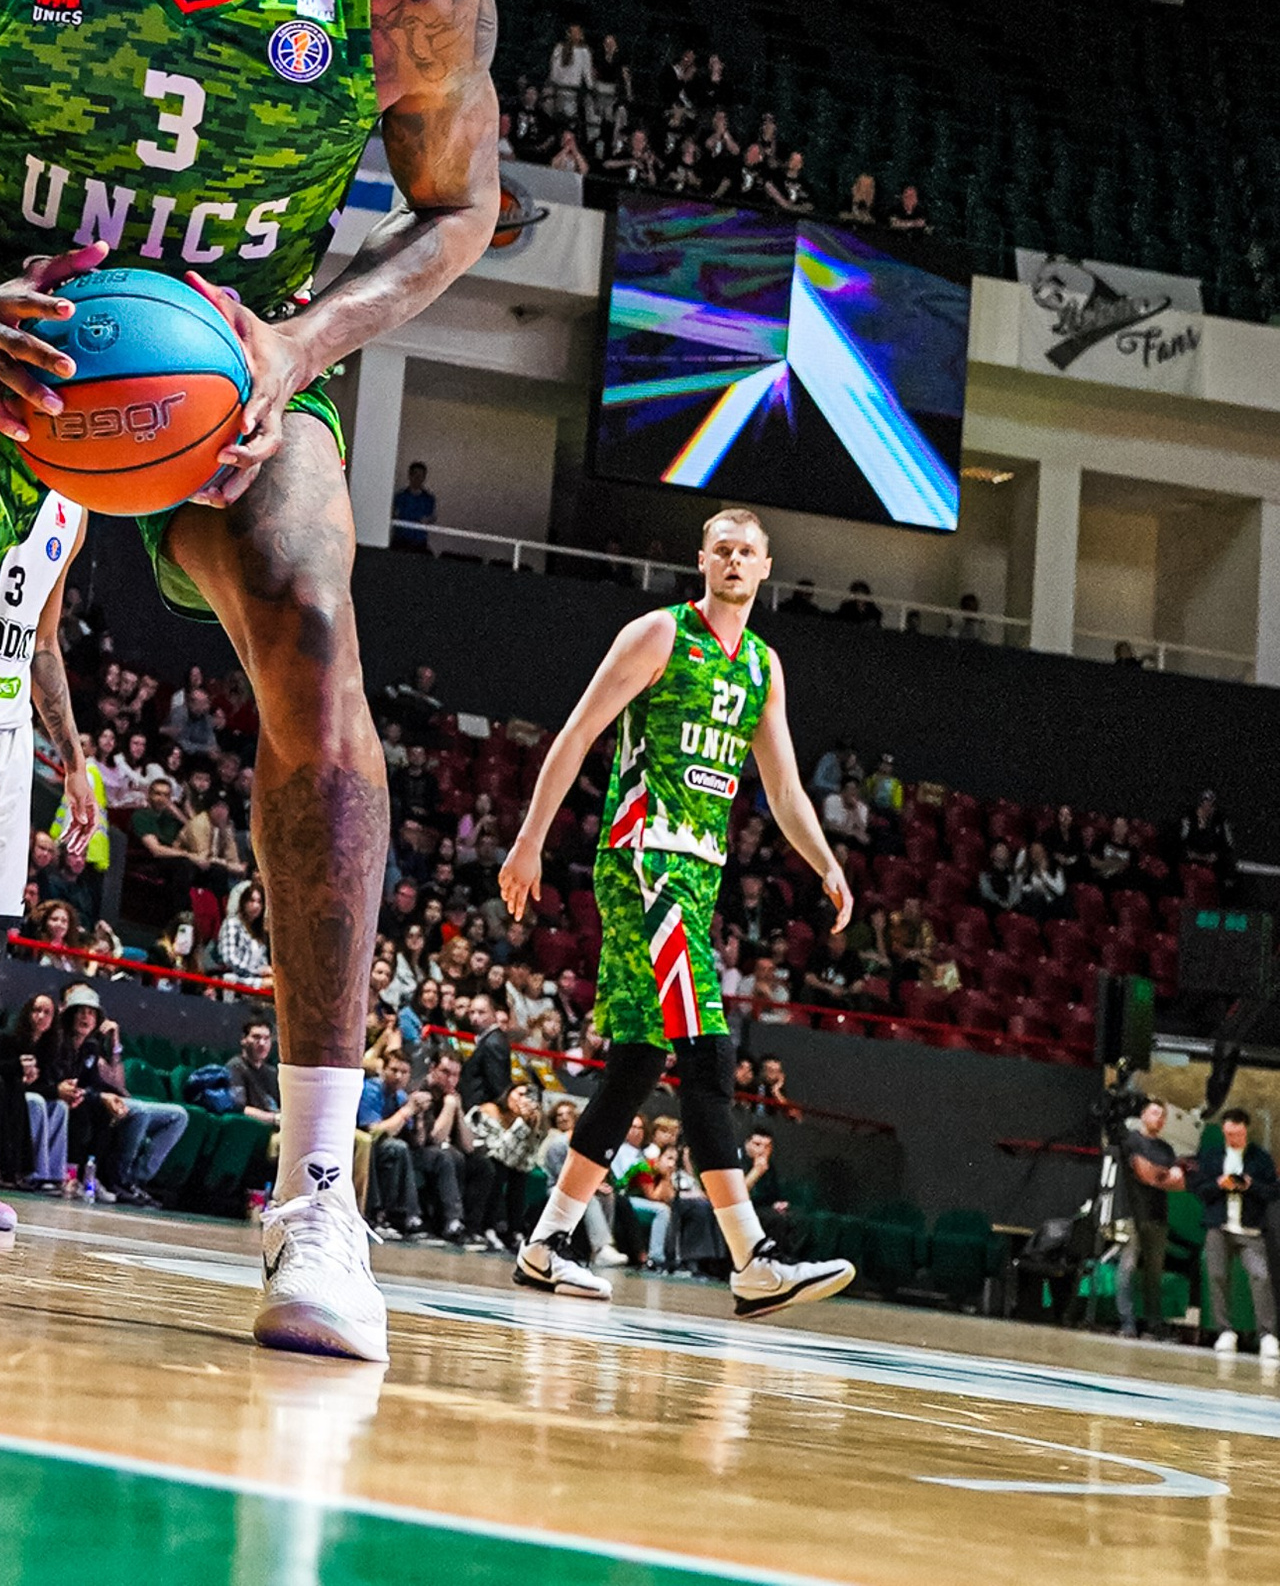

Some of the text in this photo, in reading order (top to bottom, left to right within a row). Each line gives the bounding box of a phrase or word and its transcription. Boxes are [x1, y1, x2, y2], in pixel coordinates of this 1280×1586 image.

[32, 5, 83, 26] UNICS
[136, 68, 206, 172] 3
[22, 153, 291, 264] UNICS
[710, 678, 747, 727] 27
[680, 721, 747, 767] UNIC
